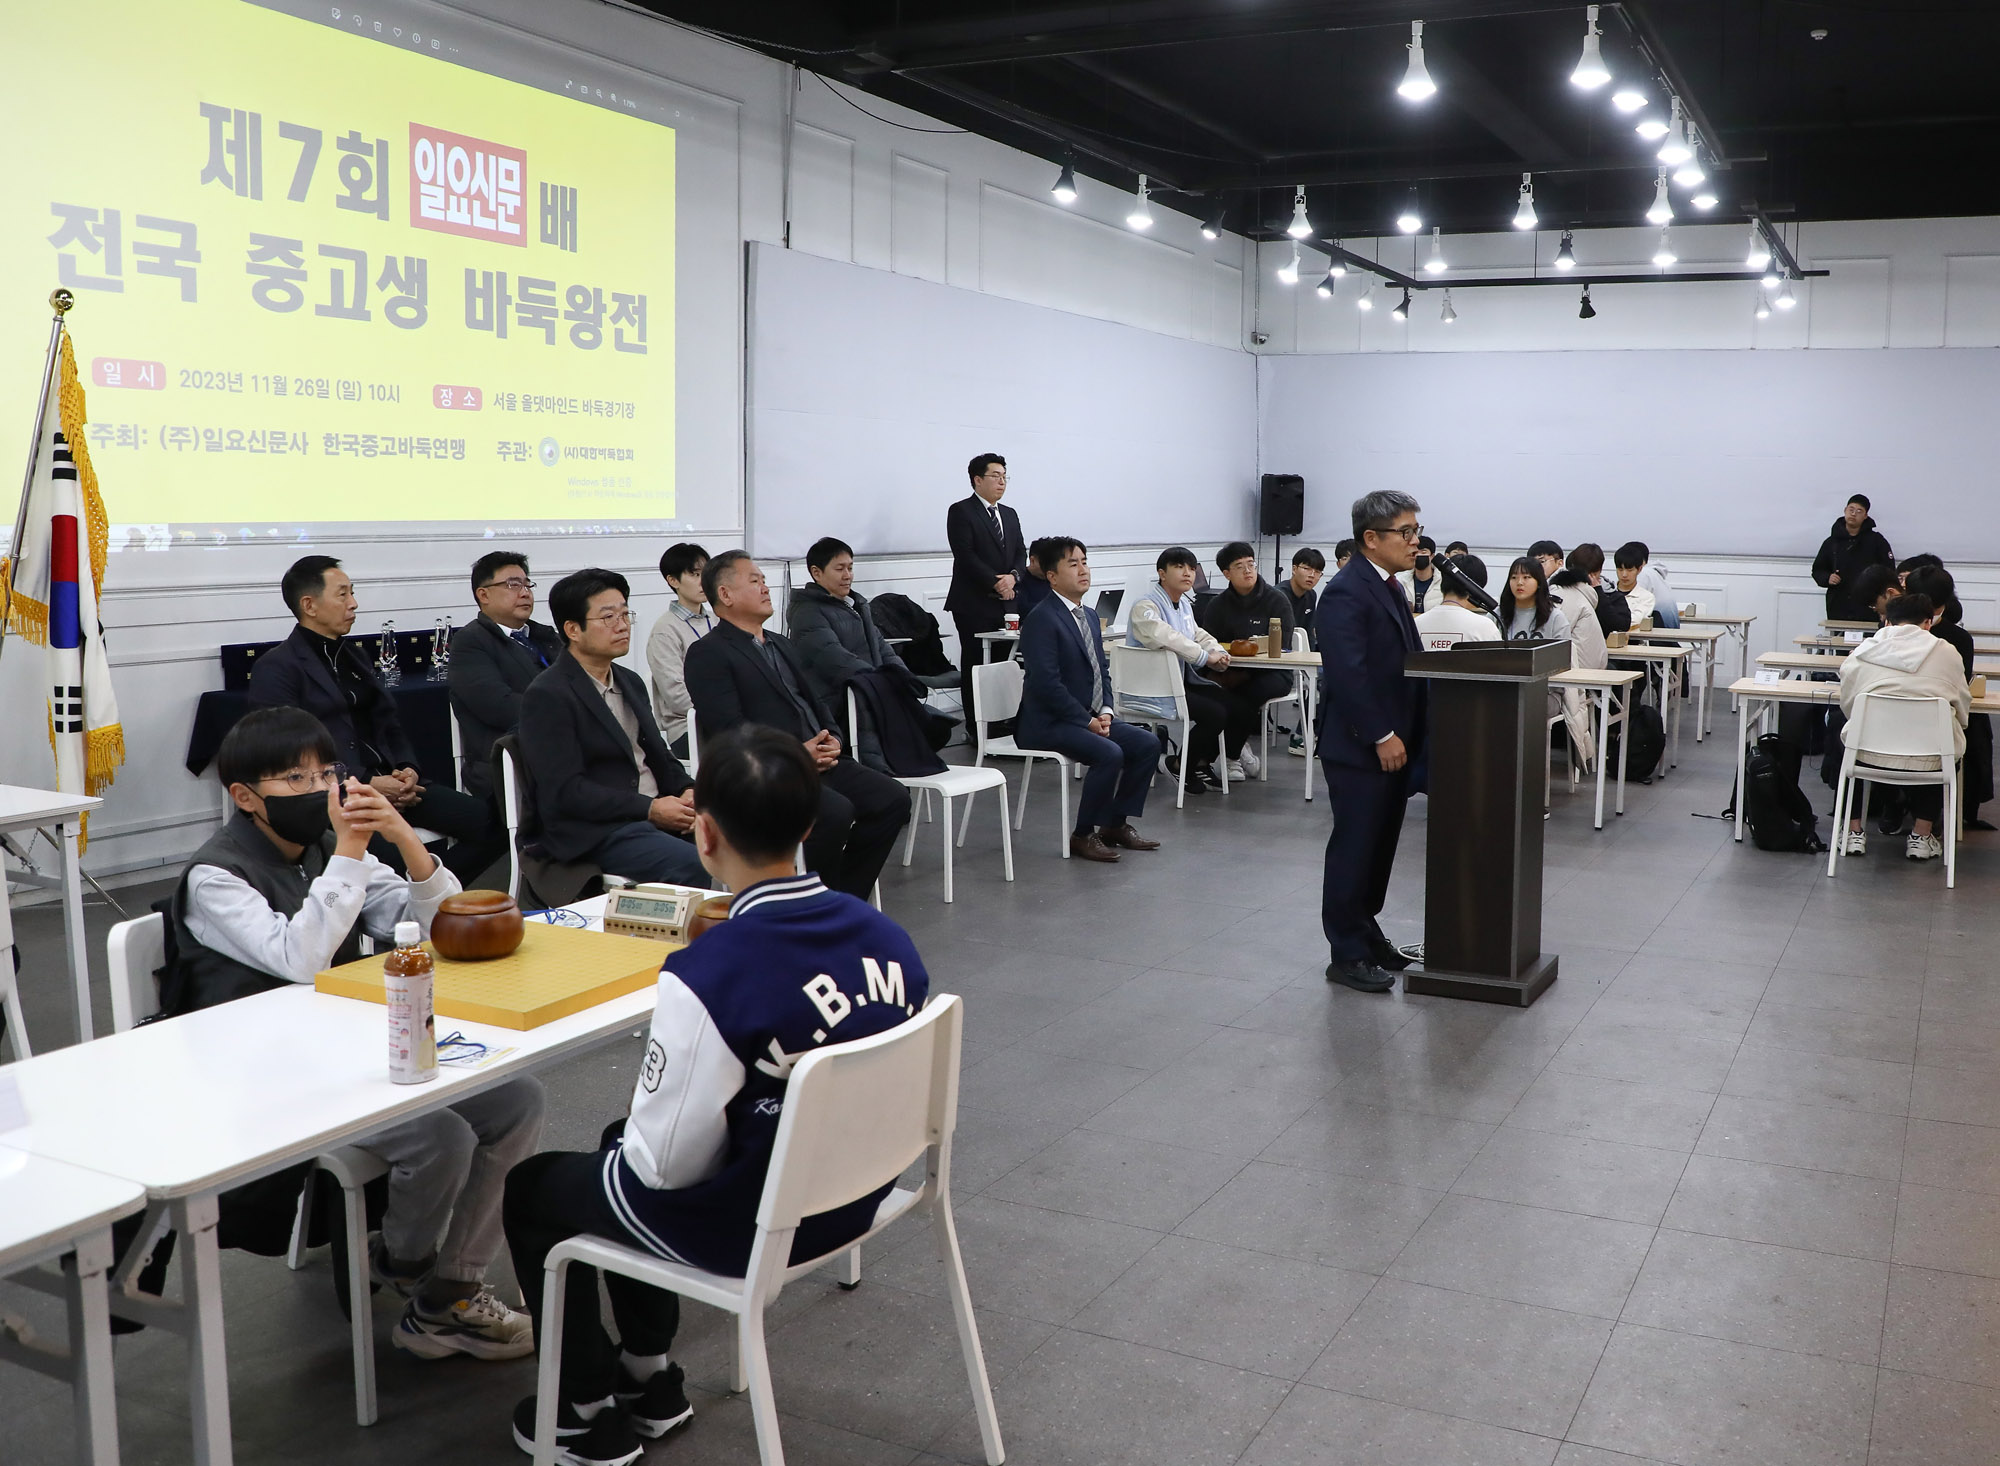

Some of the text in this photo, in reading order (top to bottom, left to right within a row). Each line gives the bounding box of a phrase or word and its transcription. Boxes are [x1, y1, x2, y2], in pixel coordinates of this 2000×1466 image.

[199, 101, 578, 254] 제7회 일요신문 배
[46, 201, 648, 356] 전국 중고생 바둑왕전
[103, 361, 156, 388] 일 시
[179, 369, 401, 404] 2023년 11월 26일 (일) 10시
[440, 387, 477, 408] 장 소
[493, 392, 636, 420] 서울 올댓마인드 바둑경기장
[90, 422, 466, 460] 주최: (주)일요신문사 한국중고바둑연맹
[496, 440, 533, 462] 주관:
[1430, 640, 1452, 649] KEEP
[755, 956, 929, 1081] K.B.M.
